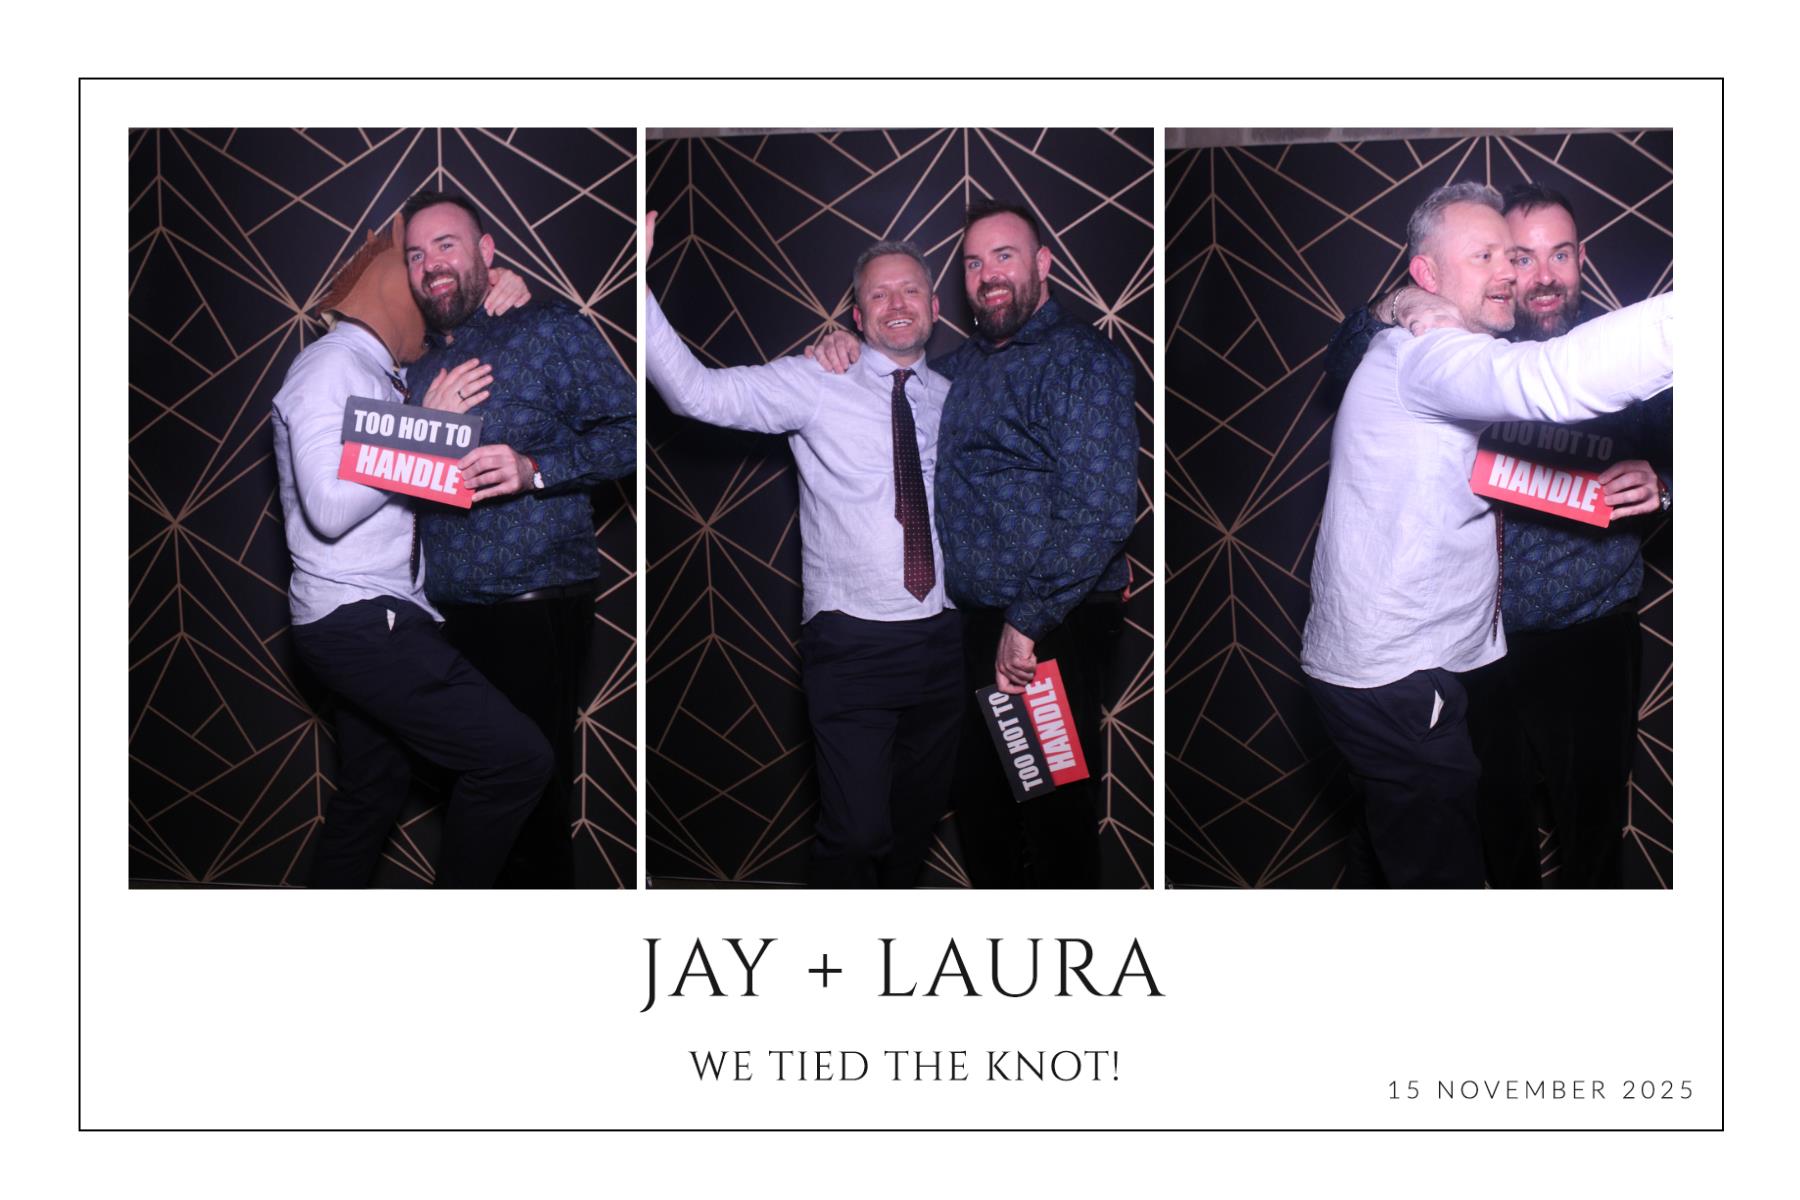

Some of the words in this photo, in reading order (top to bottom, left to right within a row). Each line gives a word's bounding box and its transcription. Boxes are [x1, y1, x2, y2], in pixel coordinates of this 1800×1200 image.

[354, 409, 394, 437] TOO
[398, 416, 442, 443] HOT
[445, 422, 472, 448] TO
[1491, 421, 1533, 446] TOO
[1537, 423, 1582, 455] HOT
[1587, 434, 1614, 461] TO
[355, 444, 462, 495] HANDLE
[1488, 454, 1601, 512] HANDLE
[988, 691, 1014, 718] TO
[998, 717, 1029, 755] HOT
[1025, 677, 1077, 772] HANDLE
[1013, 753, 1044, 792] TOO
